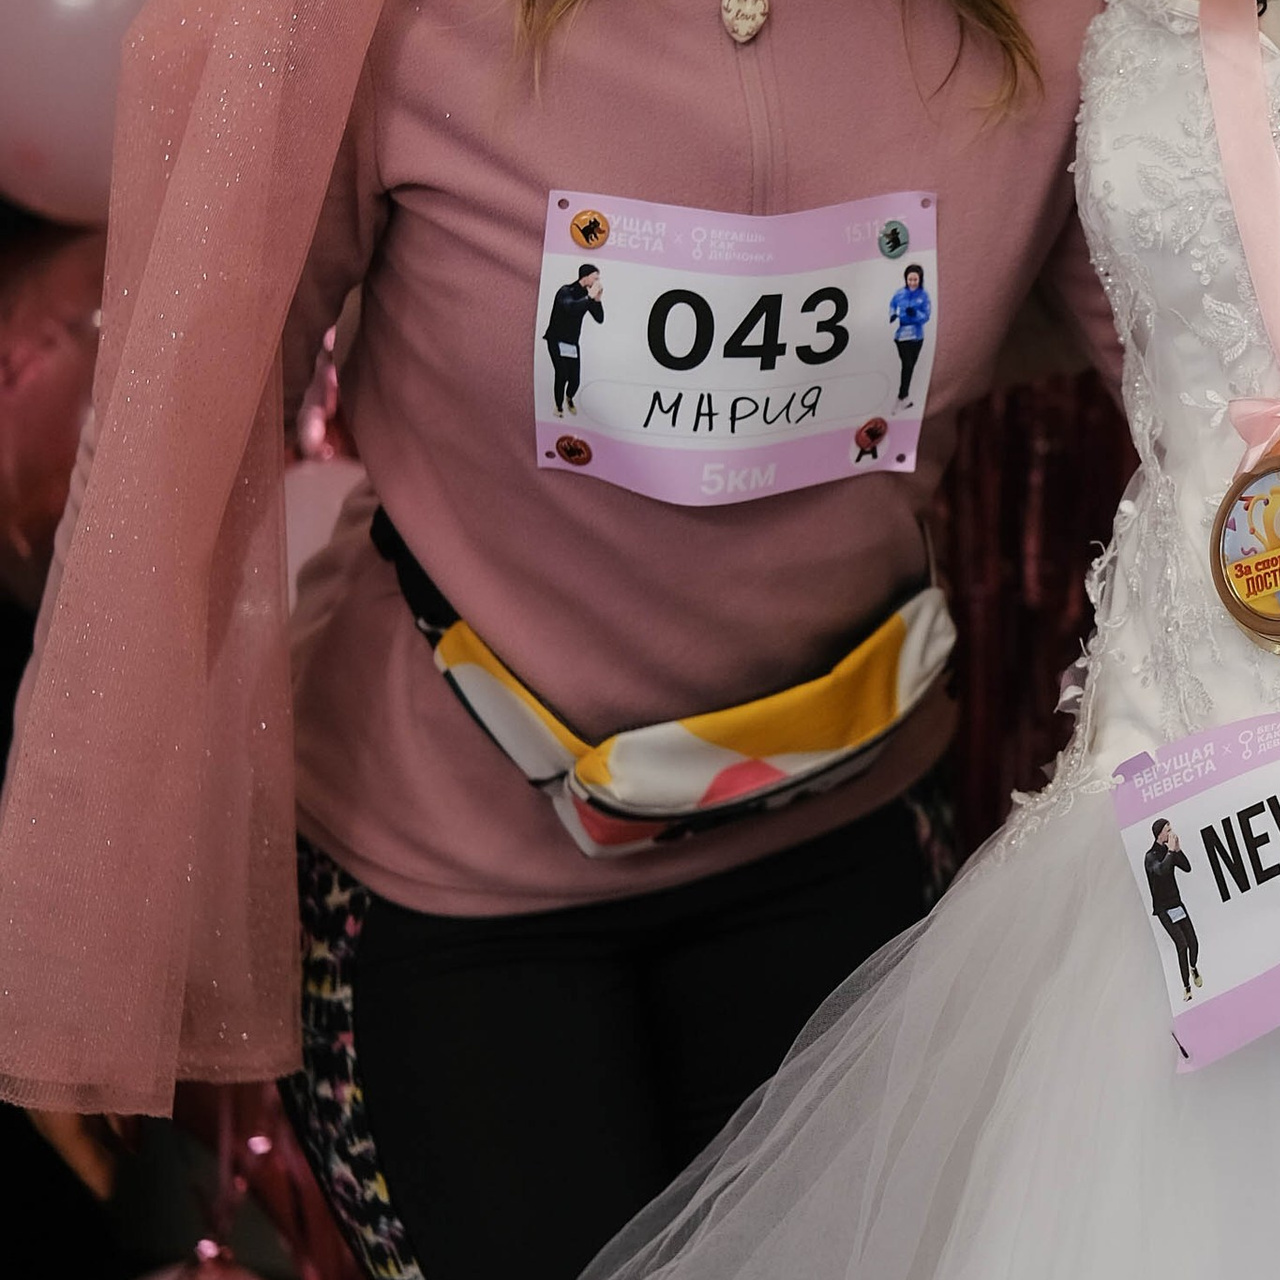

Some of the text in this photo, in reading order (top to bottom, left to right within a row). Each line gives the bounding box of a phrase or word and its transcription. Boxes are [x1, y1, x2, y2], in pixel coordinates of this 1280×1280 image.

[608, 214, 667, 237] УЩАЯ
[647, 286, 849, 371] 043
[643, 385, 822, 434] МАРИЯ
[1234, 563, 1252, 579] За
[1132, 741, 1215, 789] БЕГУЩАЯ
[1141, 758, 1217, 803] НЕВЕСТА
